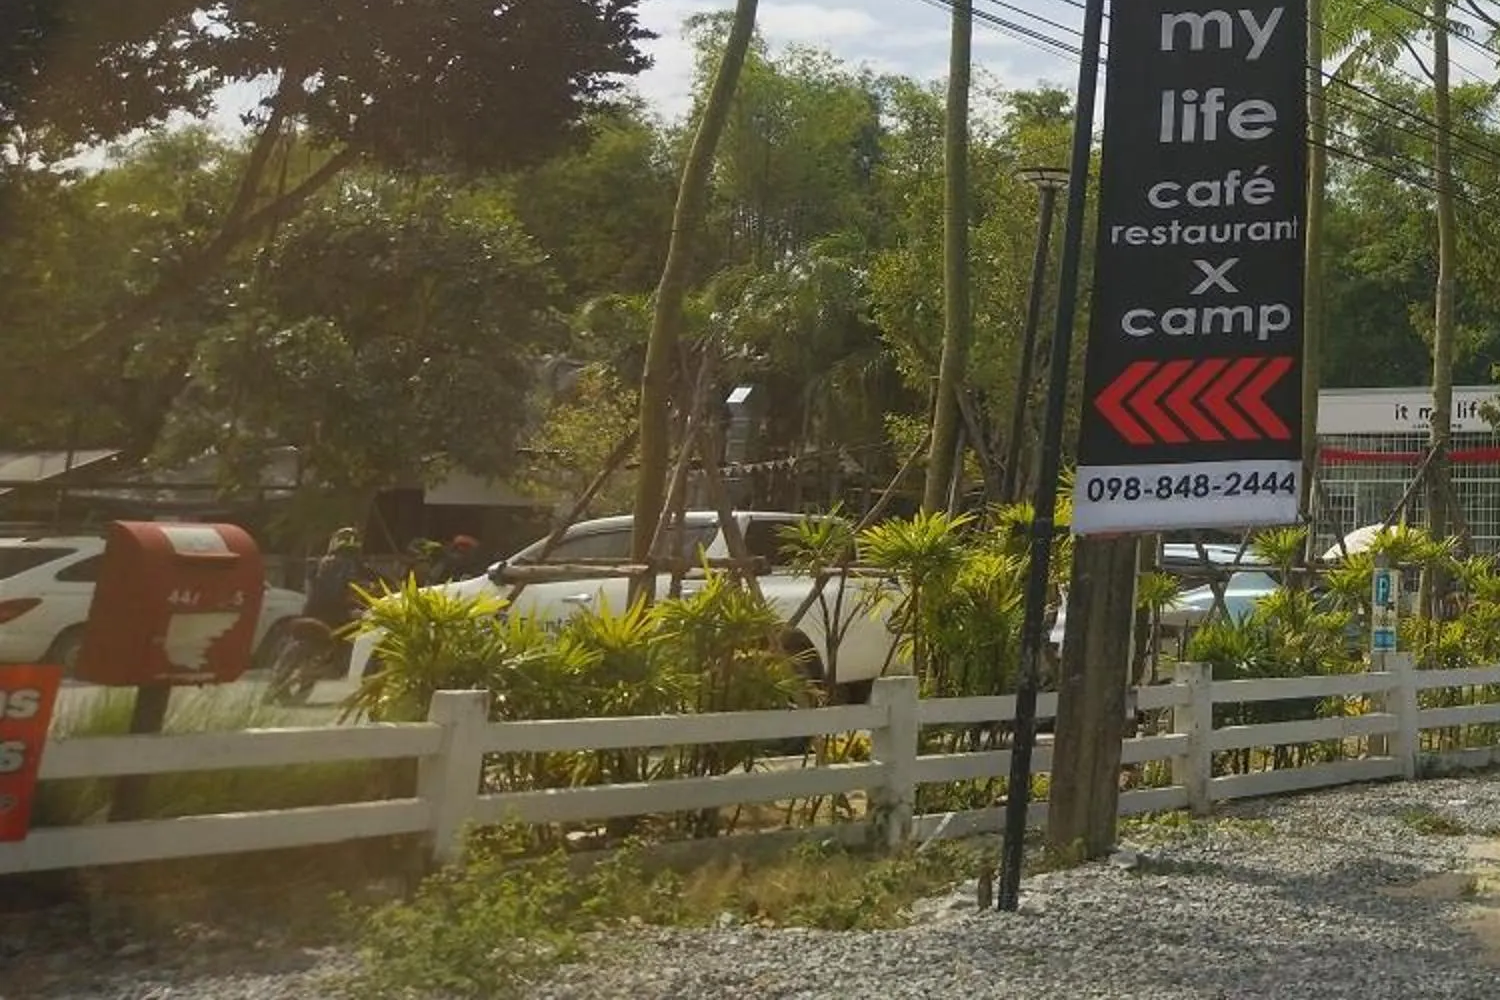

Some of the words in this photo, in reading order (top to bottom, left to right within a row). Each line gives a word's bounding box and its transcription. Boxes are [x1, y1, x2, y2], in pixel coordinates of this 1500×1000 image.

[1160, 6, 1285, 60] my
[1159, 87, 1277, 143] life
[1147, 165, 1275, 209] café
[1121, 303, 1291, 341] camp
[1087, 471, 1296, 503] 098-848-2444
